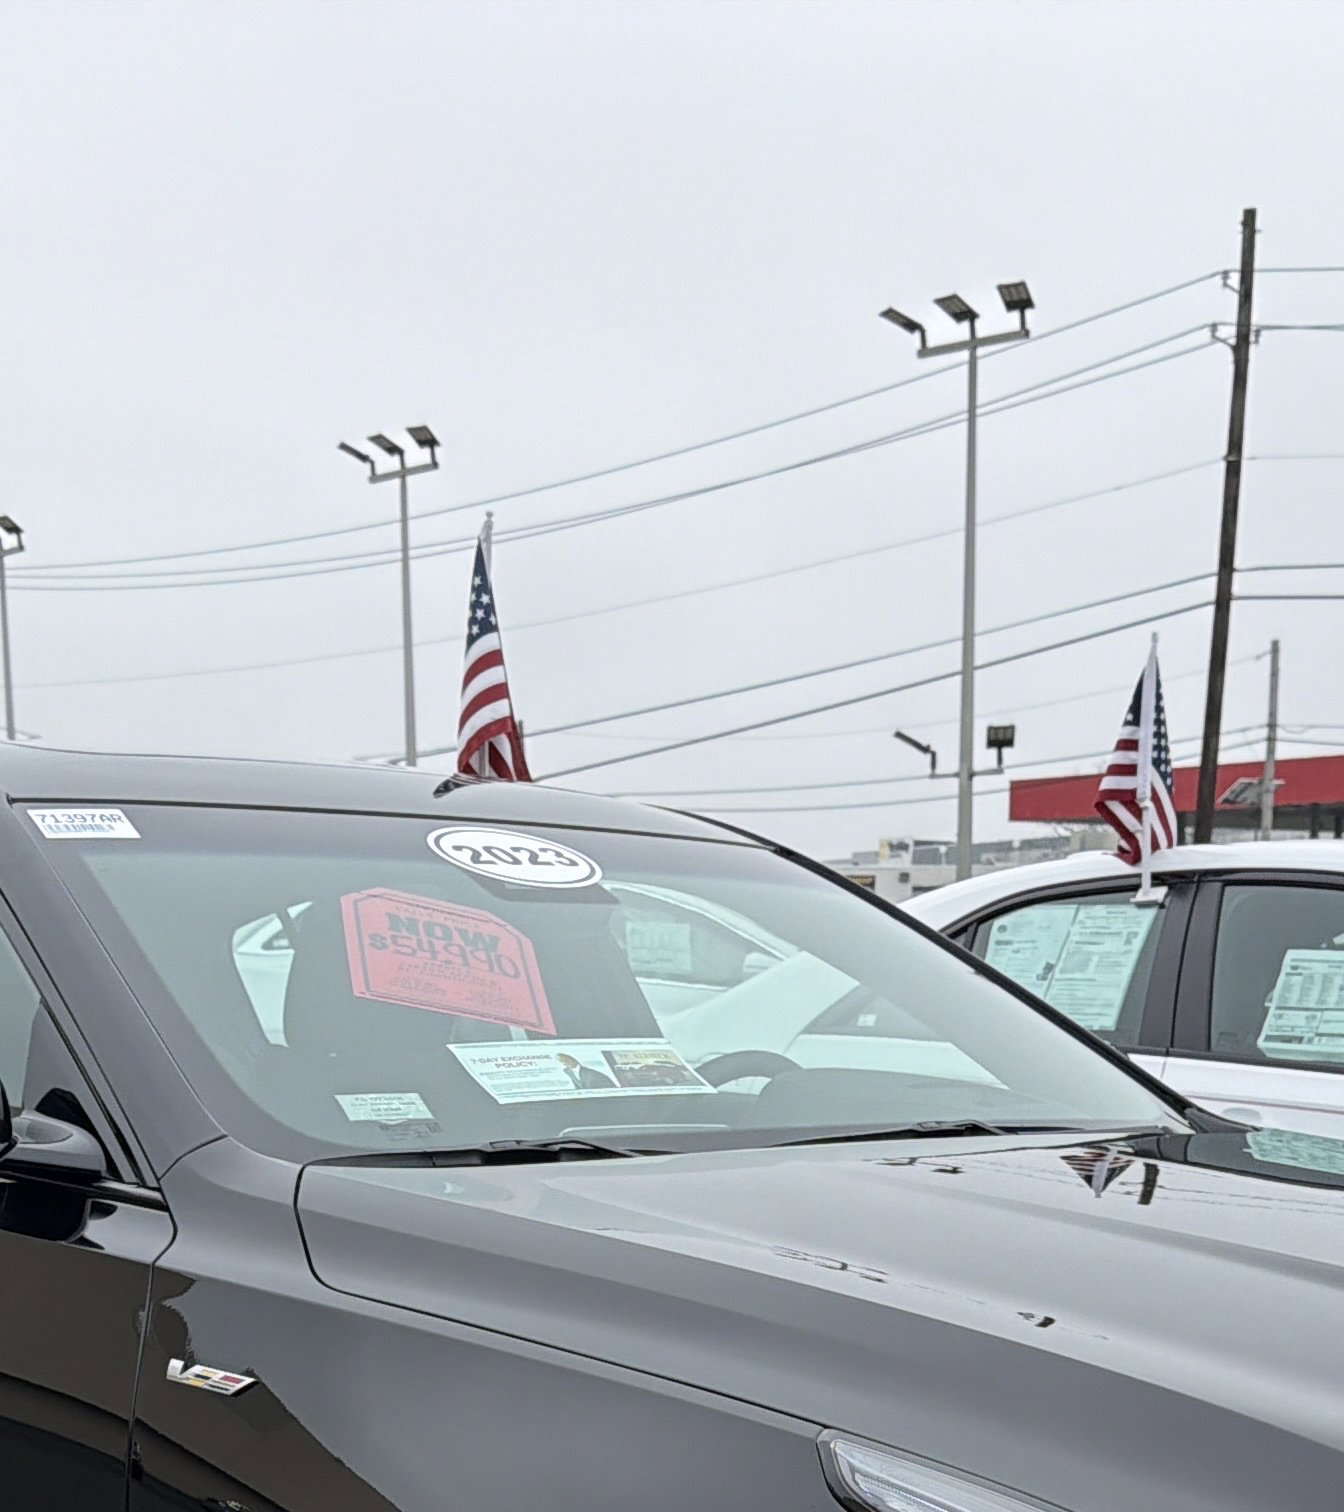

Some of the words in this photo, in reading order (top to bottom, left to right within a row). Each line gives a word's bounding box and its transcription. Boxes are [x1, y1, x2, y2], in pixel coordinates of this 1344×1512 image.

[34, 813, 126, 824] 71397AR
[450, 844, 580, 868] 2023
[385, 911, 501, 953] NOW
